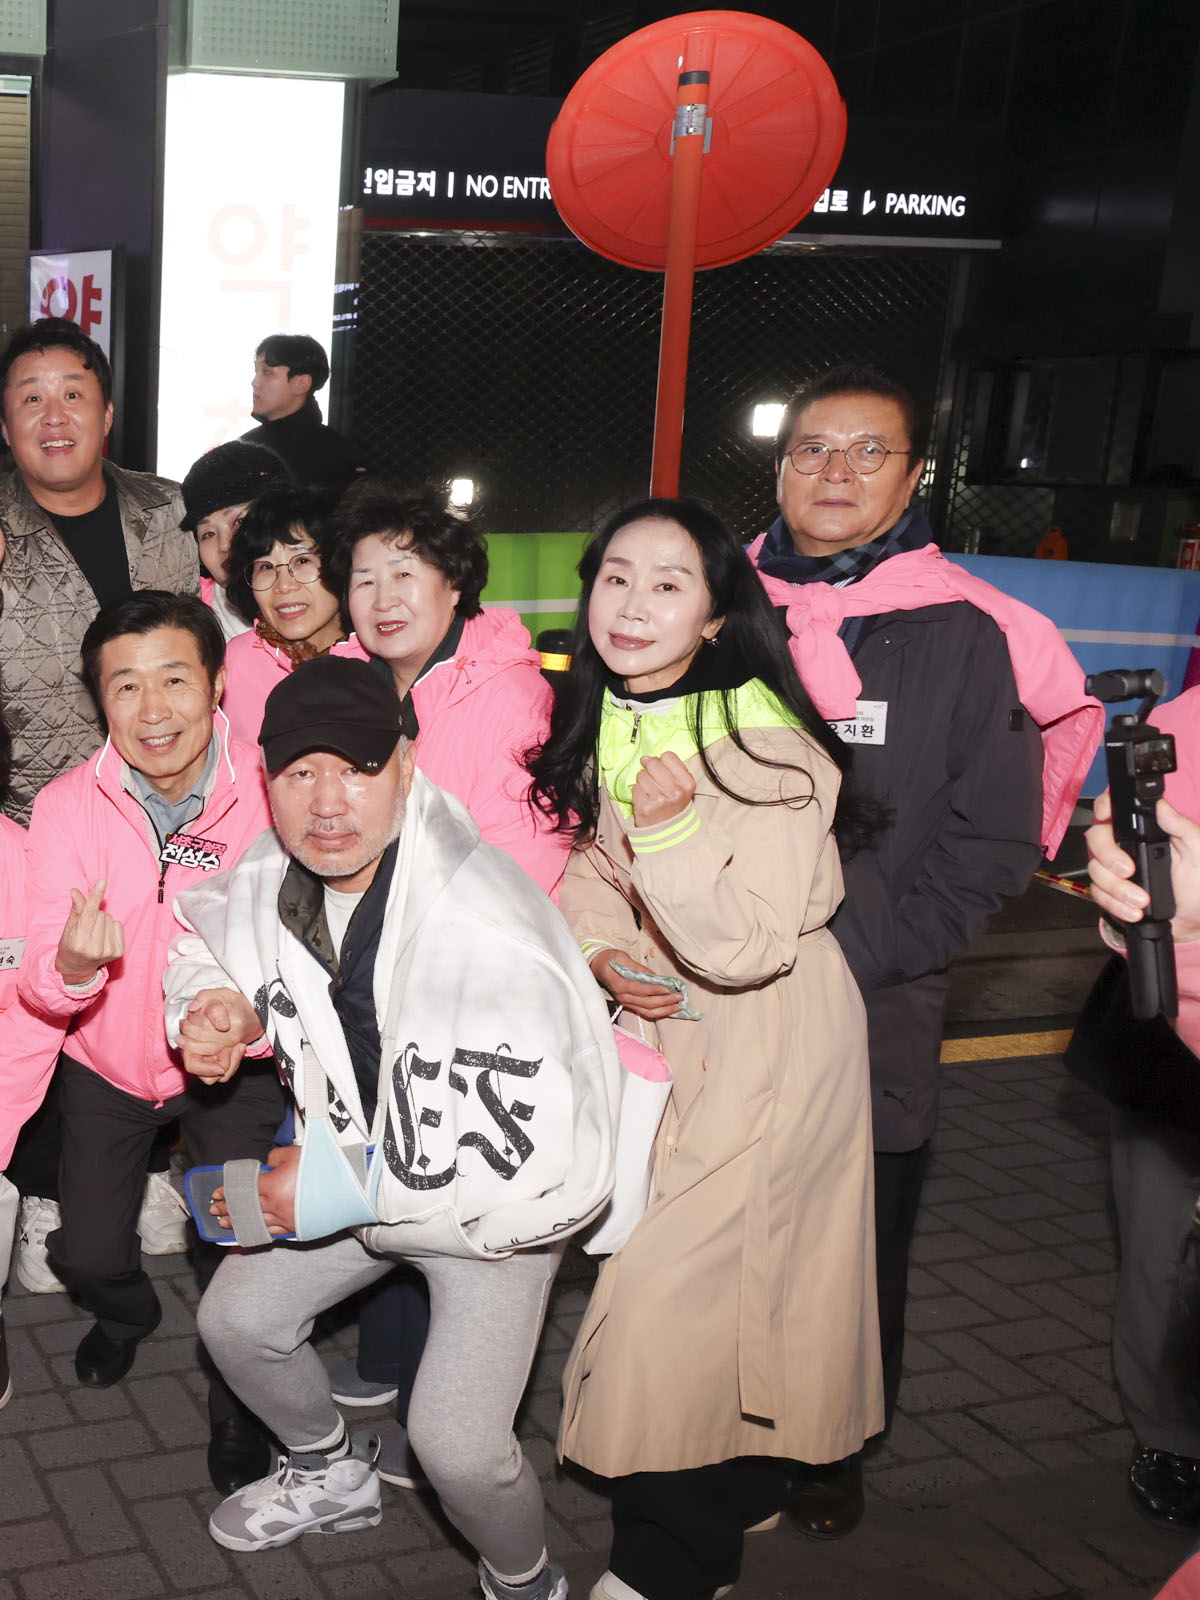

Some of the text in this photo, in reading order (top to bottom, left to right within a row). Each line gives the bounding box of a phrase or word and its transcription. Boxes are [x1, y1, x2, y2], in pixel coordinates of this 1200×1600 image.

[466, 174, 552, 200] NO ENTR
[885, 192, 966, 217] PARKING
[207, 203, 311, 330] 약
[160, 843, 220, 872] 전성수
[169, 833, 225, 856] 서초구청장
